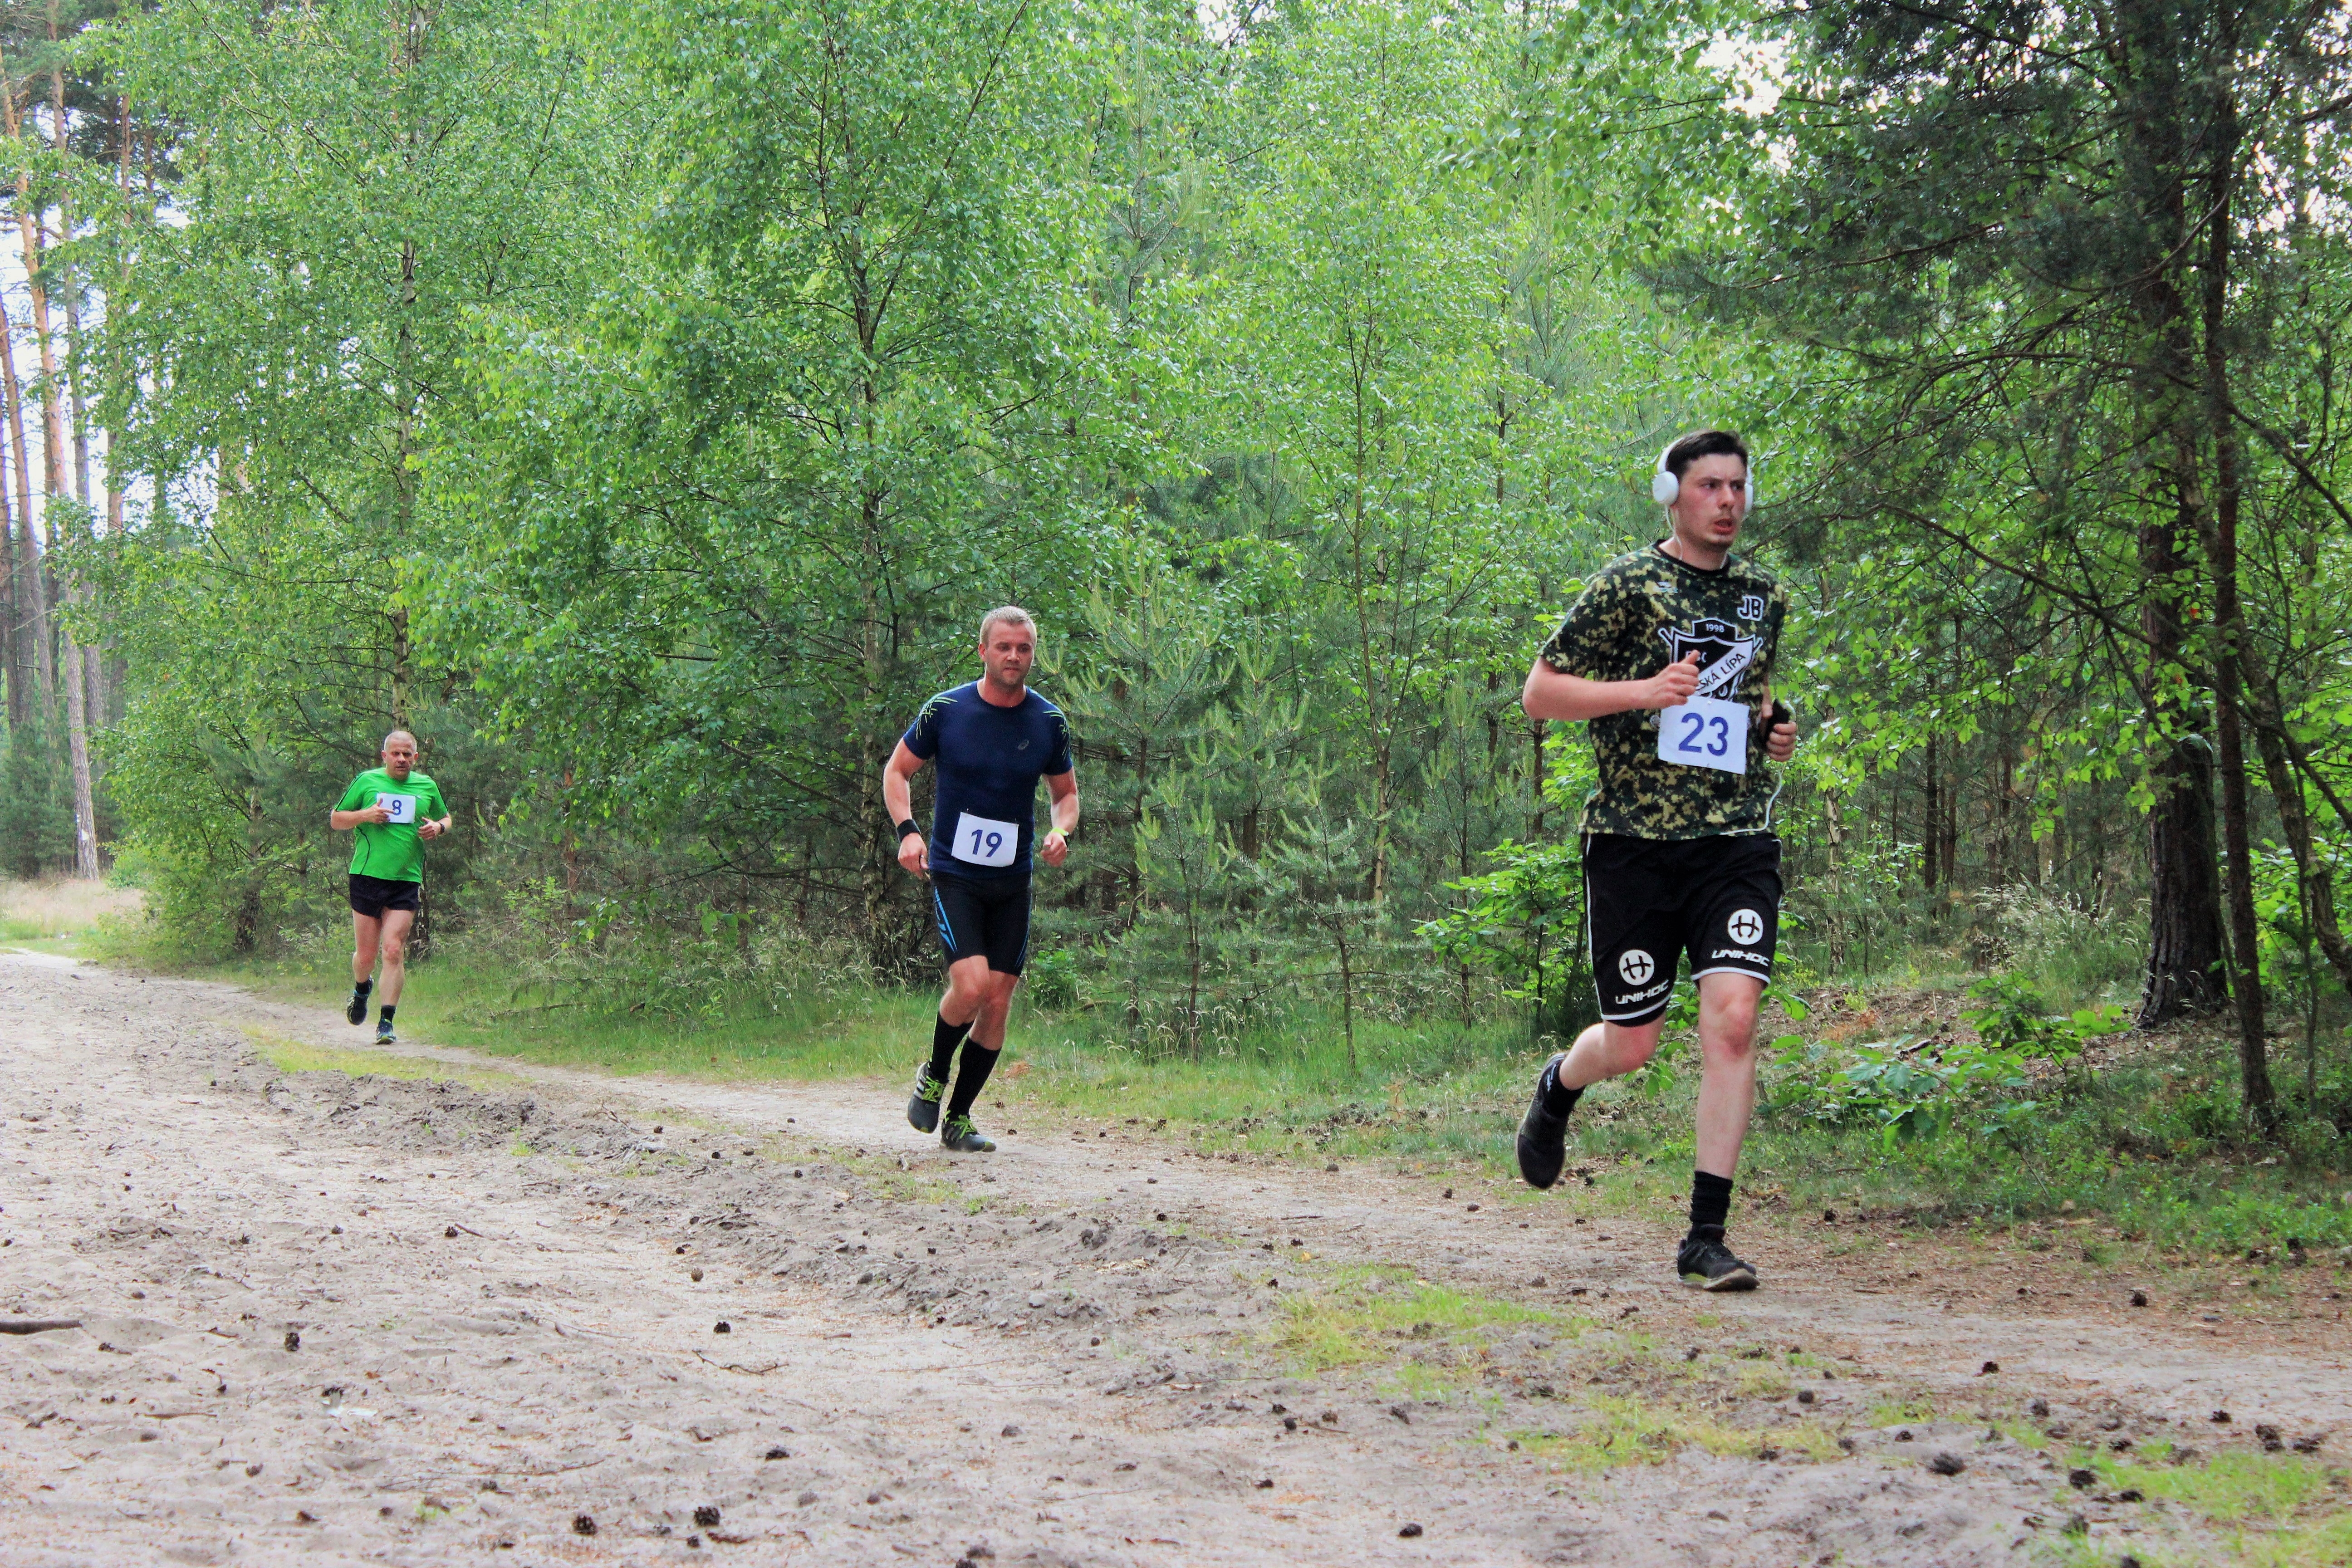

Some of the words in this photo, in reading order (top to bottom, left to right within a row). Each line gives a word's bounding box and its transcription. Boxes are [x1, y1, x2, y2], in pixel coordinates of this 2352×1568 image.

[1737, 595, 1764, 622] JB
[1705, 623, 1725, 633] 1998
[1695, 669, 1721, 691] SKÁ
[1720, 653, 1746, 675] LÍPA
[1679, 712, 1729, 756] 23
[392, 799, 402, 816] 8
[971, 829, 1002, 858] 19
[1711, 949, 1770, 967] UNIHOC
[1615, 979, 1669, 1005] UNIHOC
